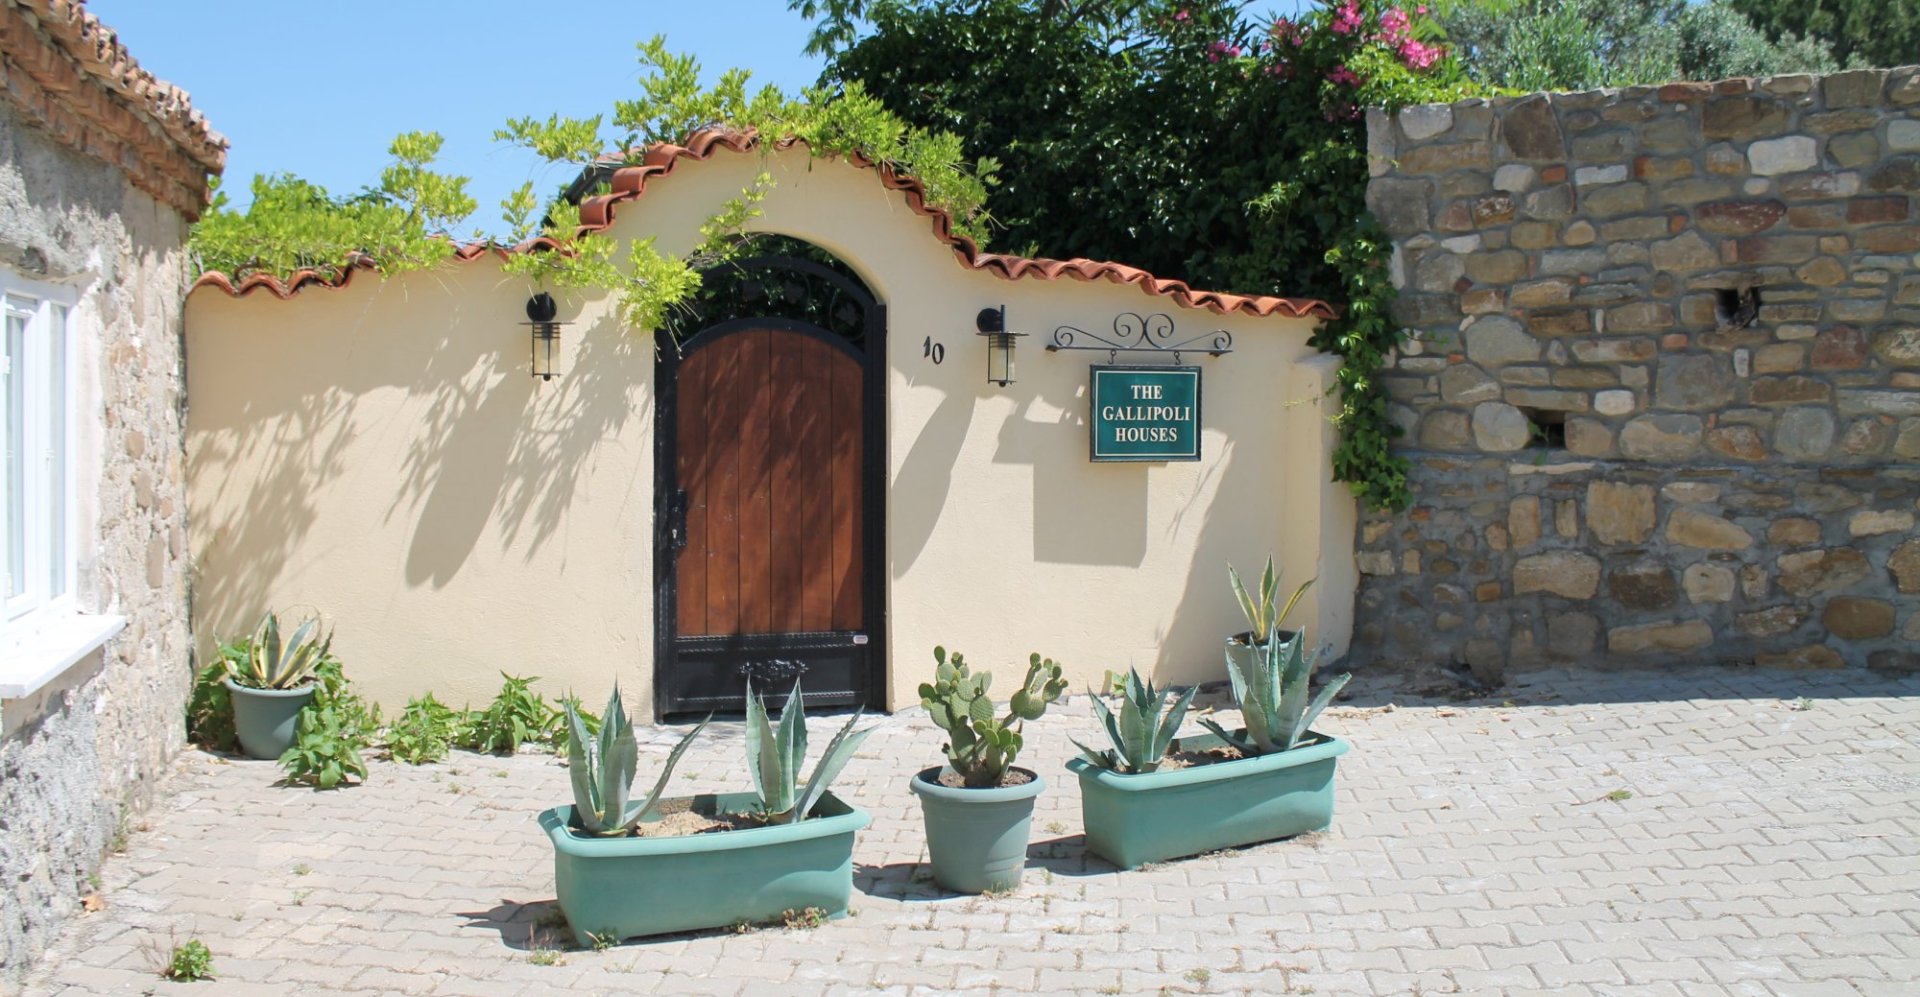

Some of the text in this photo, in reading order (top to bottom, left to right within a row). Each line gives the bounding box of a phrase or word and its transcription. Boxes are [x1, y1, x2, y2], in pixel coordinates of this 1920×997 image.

[923, 335, 945, 365] 10
[1131, 385, 1163, 400] THE
[1102, 406, 1191, 421] GALLIPOLI
[1115, 427, 1178, 442] HOUSES
